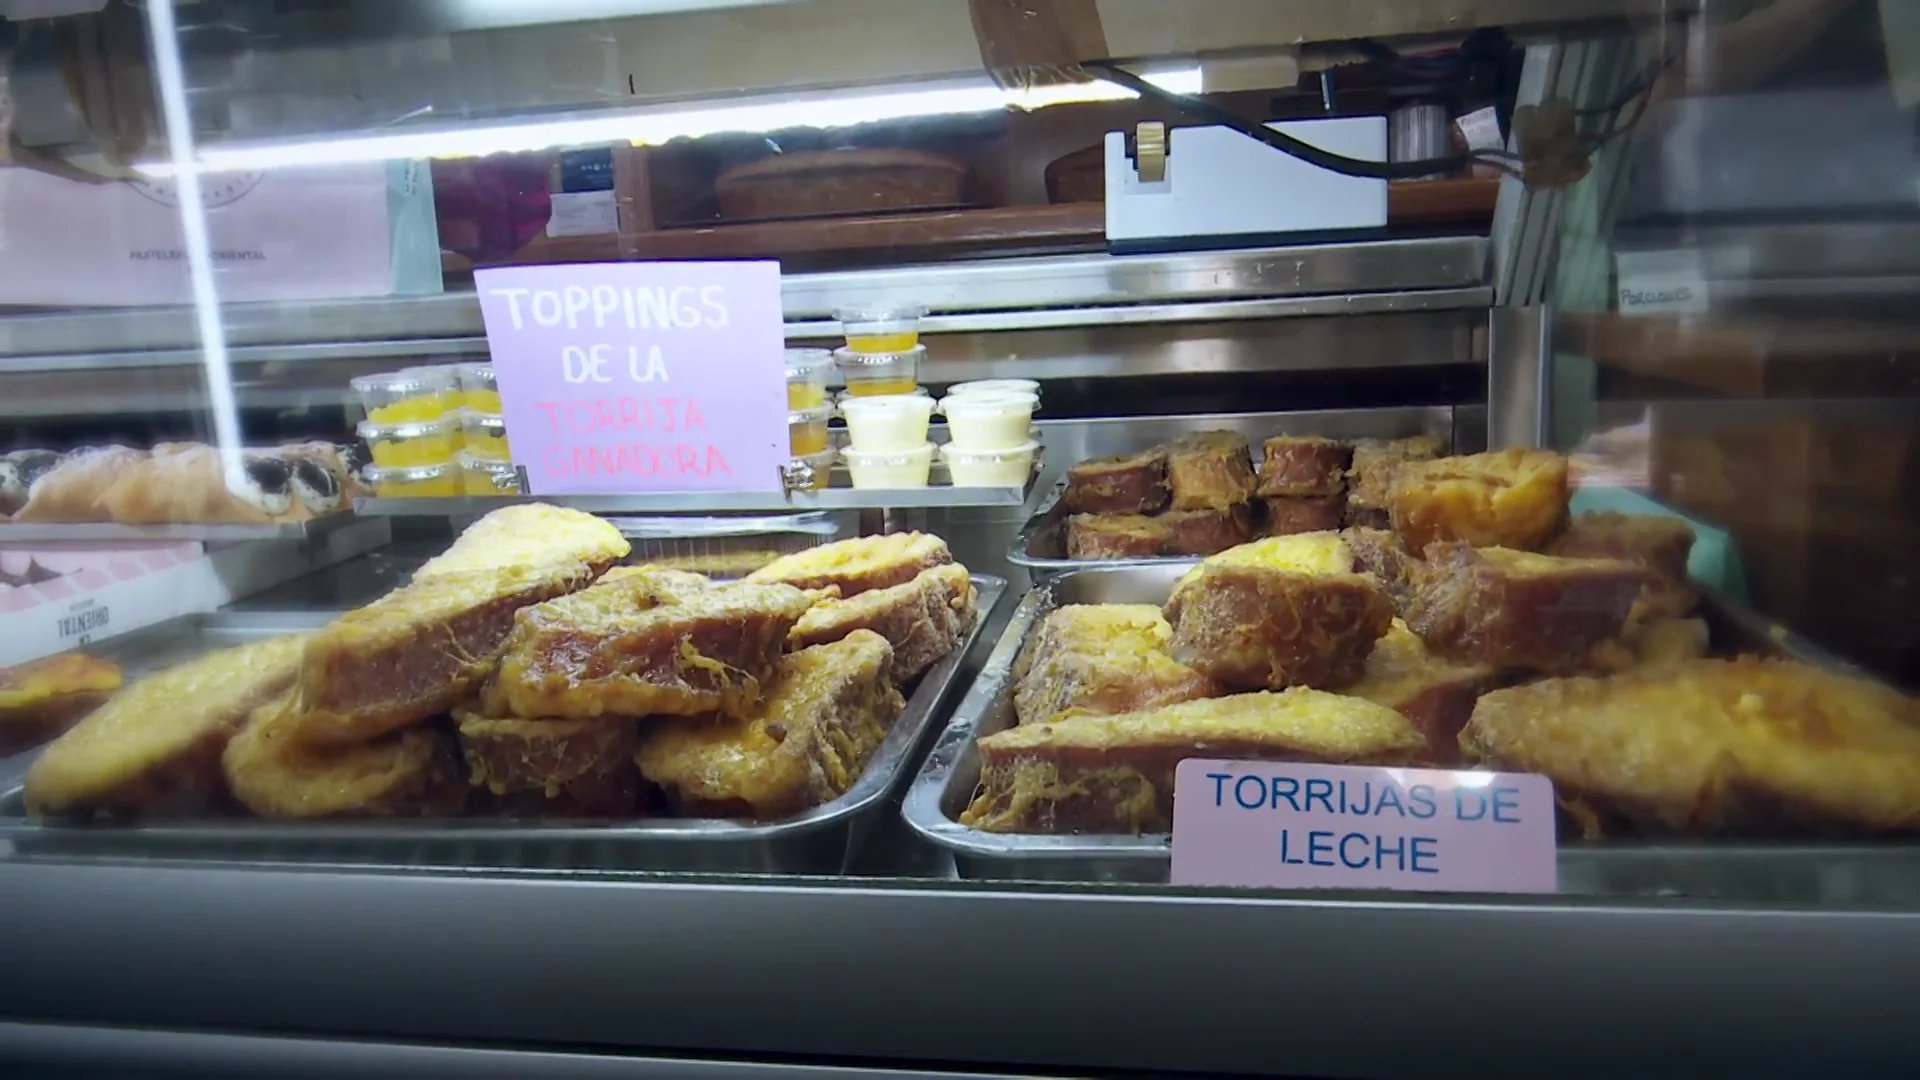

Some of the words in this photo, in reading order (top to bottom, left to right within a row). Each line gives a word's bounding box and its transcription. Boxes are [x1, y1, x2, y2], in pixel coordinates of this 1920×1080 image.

[490, 285, 731, 330] TOPPINGS
[562, 344, 613, 383] DE
[629, 345, 670, 382] LA
[534, 397, 708, 433] TORRIJA
[542, 444, 733, 477] GANADORA
[58, 606, 109, 637] ORIENTAL
[1206, 773, 1437, 819] TORRIJAS
[1455, 786, 1522, 823] DE
[1280, 829, 1440, 873] LECHE
